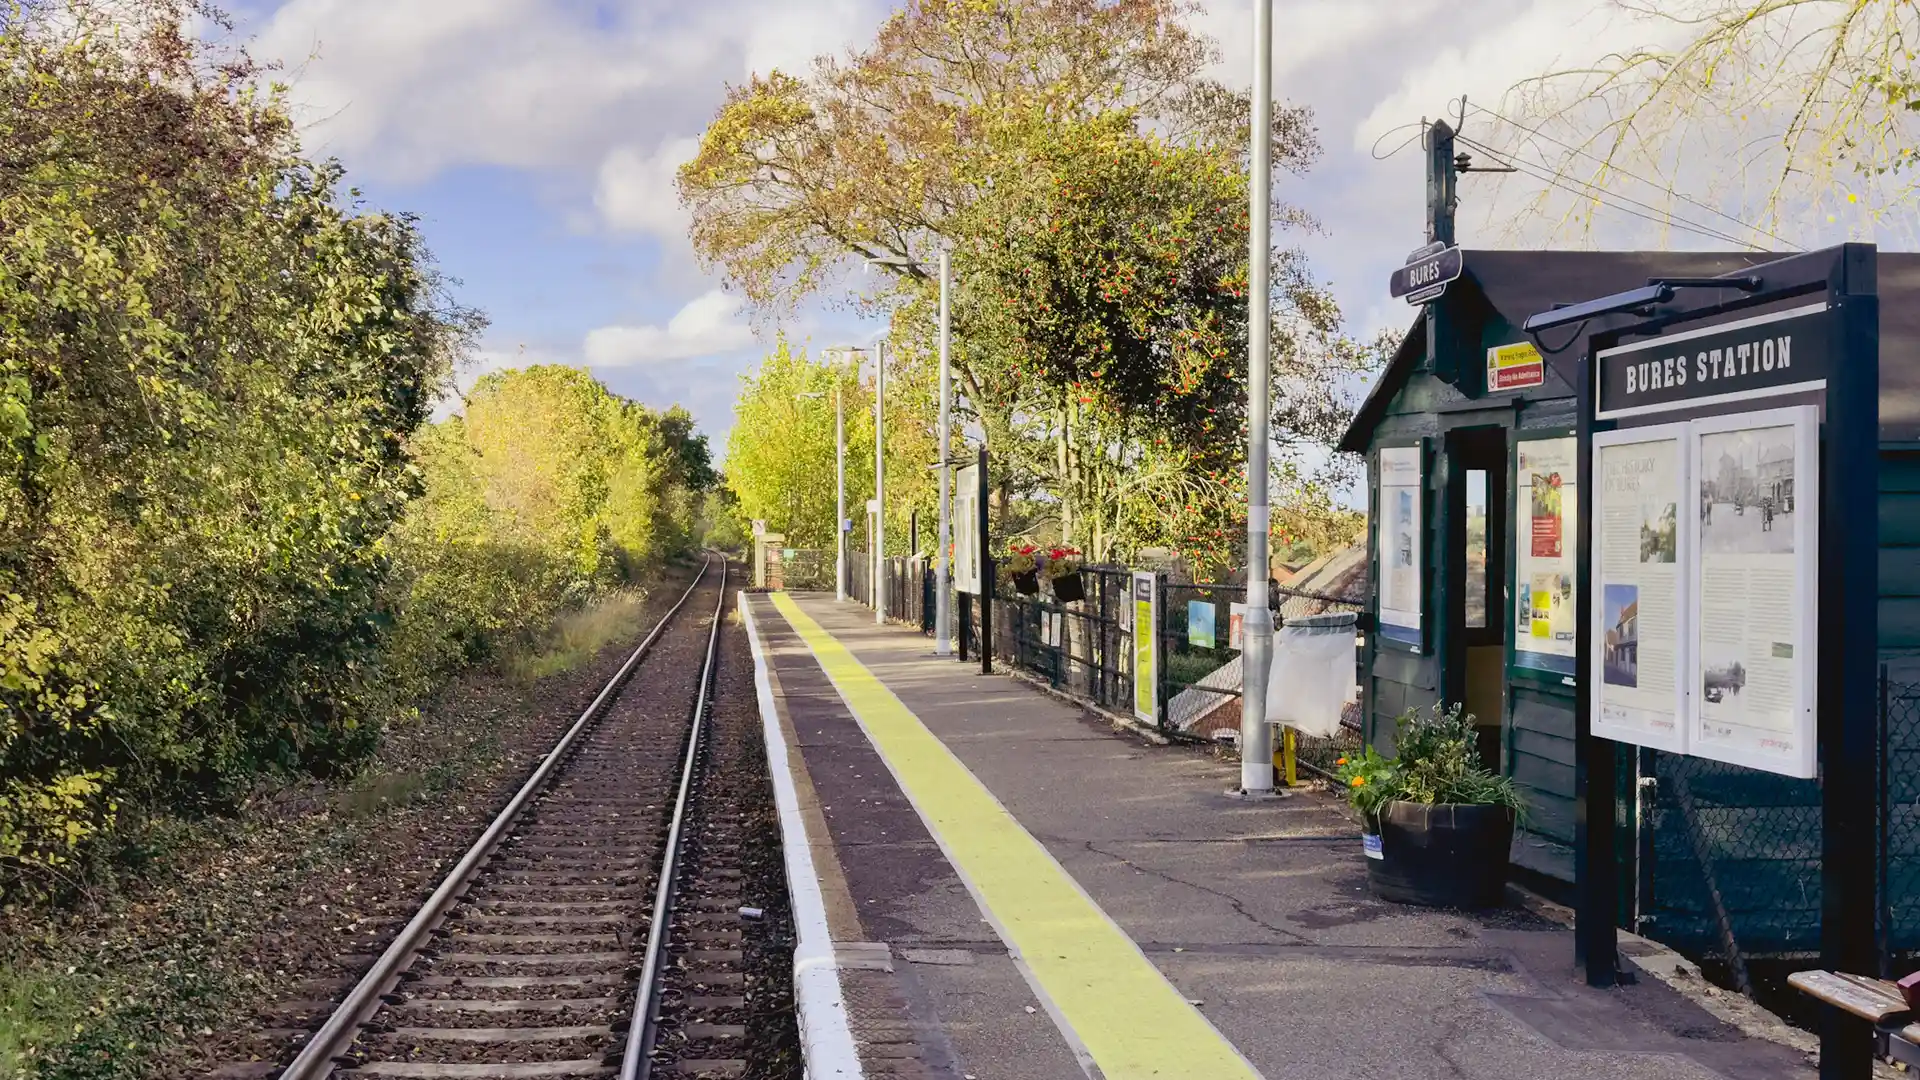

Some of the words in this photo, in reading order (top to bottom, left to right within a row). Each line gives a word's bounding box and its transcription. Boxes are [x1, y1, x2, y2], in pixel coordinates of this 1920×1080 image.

[1409, 260, 1440, 288] BURES
[1626, 355, 1688, 395] BURES
[1696, 335, 1792, 383] STATION
[1621, 457, 1656, 474] HISTORY
